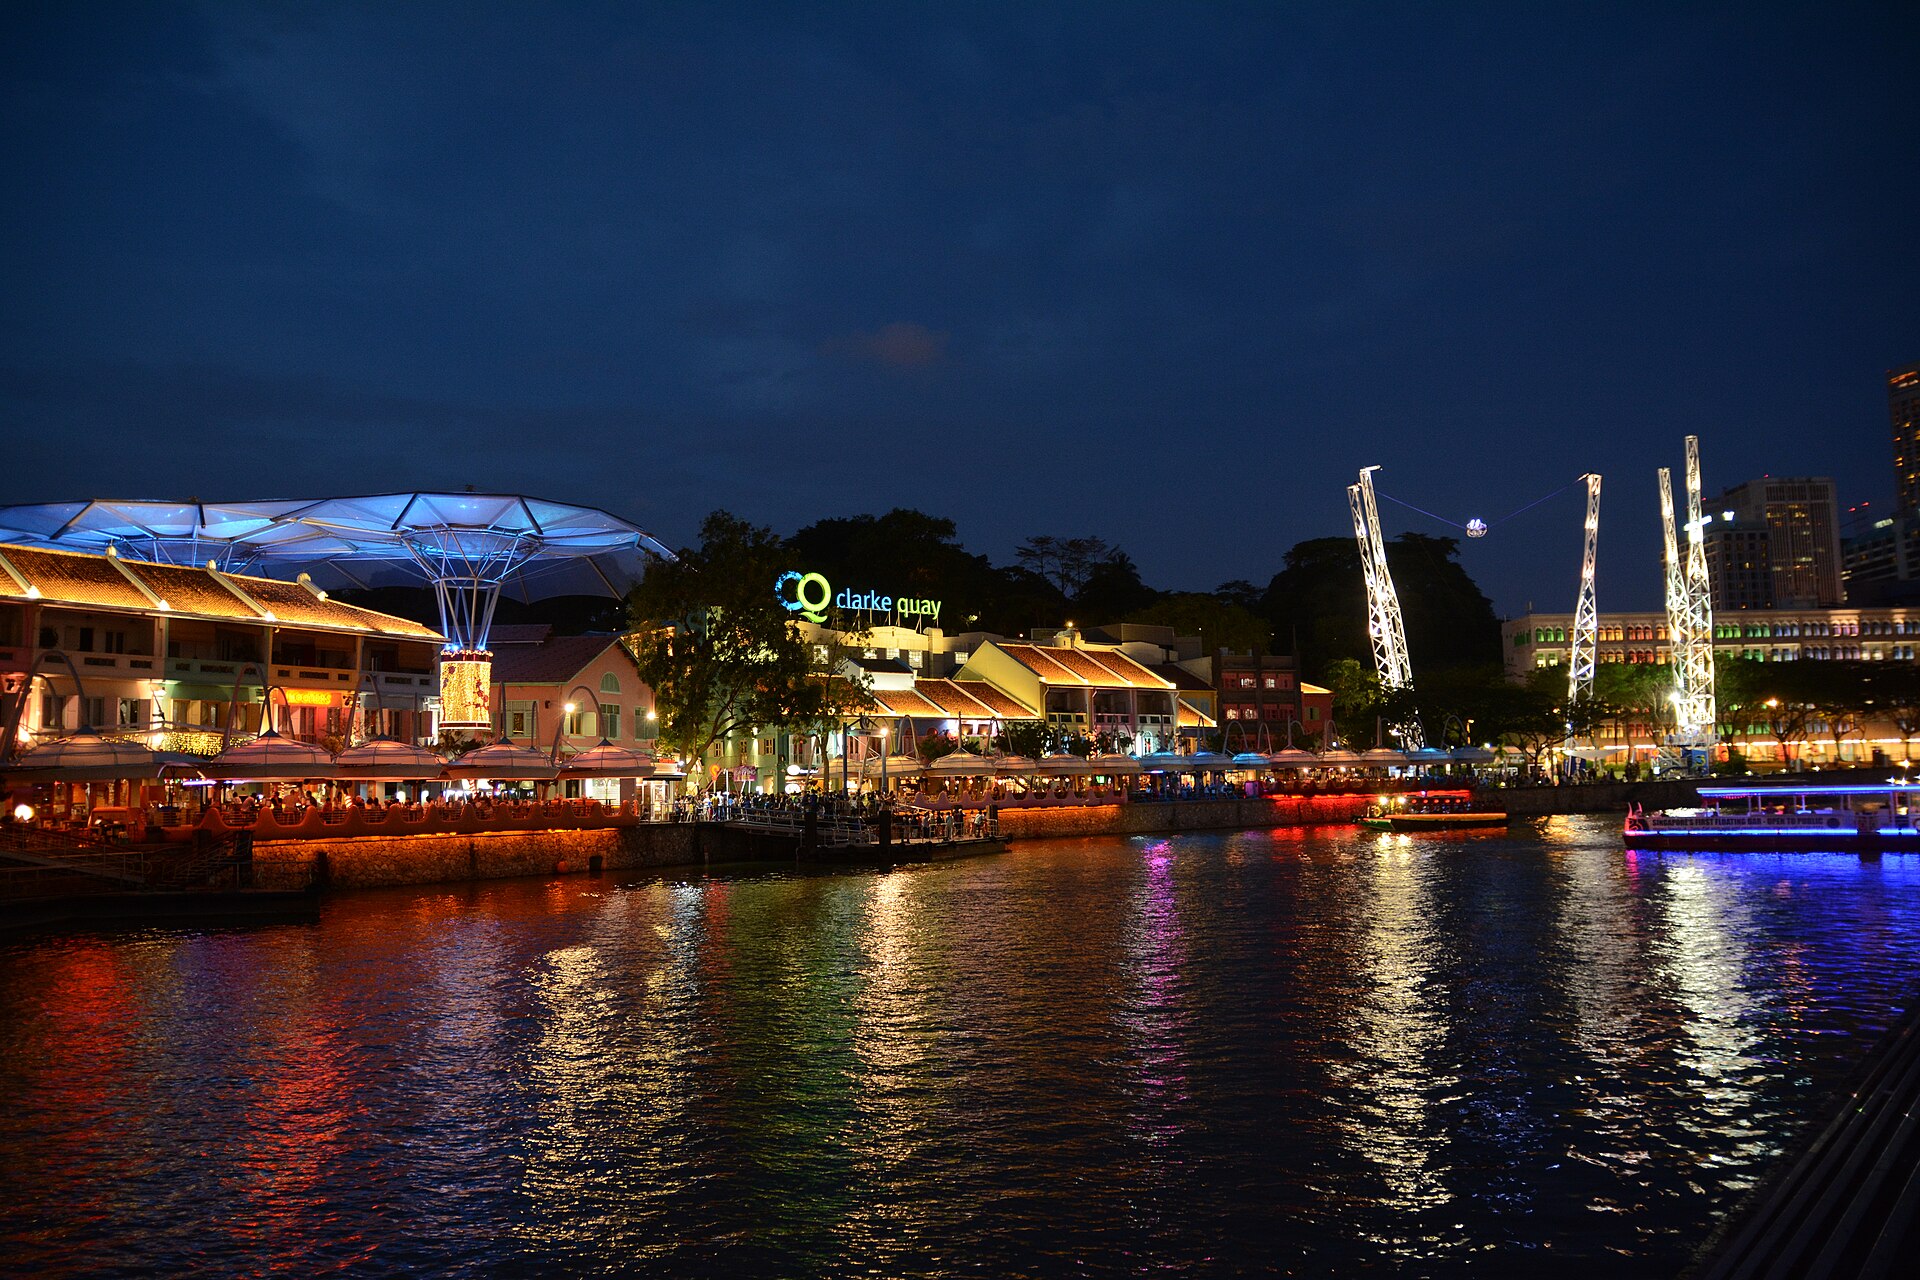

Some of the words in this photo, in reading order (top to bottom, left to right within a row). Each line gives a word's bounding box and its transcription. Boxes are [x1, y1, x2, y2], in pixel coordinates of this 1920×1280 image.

[836, 587, 892, 611] clarke
[897, 597, 942, 620] quay
[1695, 818, 1713, 826] FIRST
[1714, 818, 1746, 826] FLOATING
[1767, 817, 1785, 825] OPEN
[1786, 817, 1796, 825] TO
[1797, 817, 1823, 825] PUBLIC
